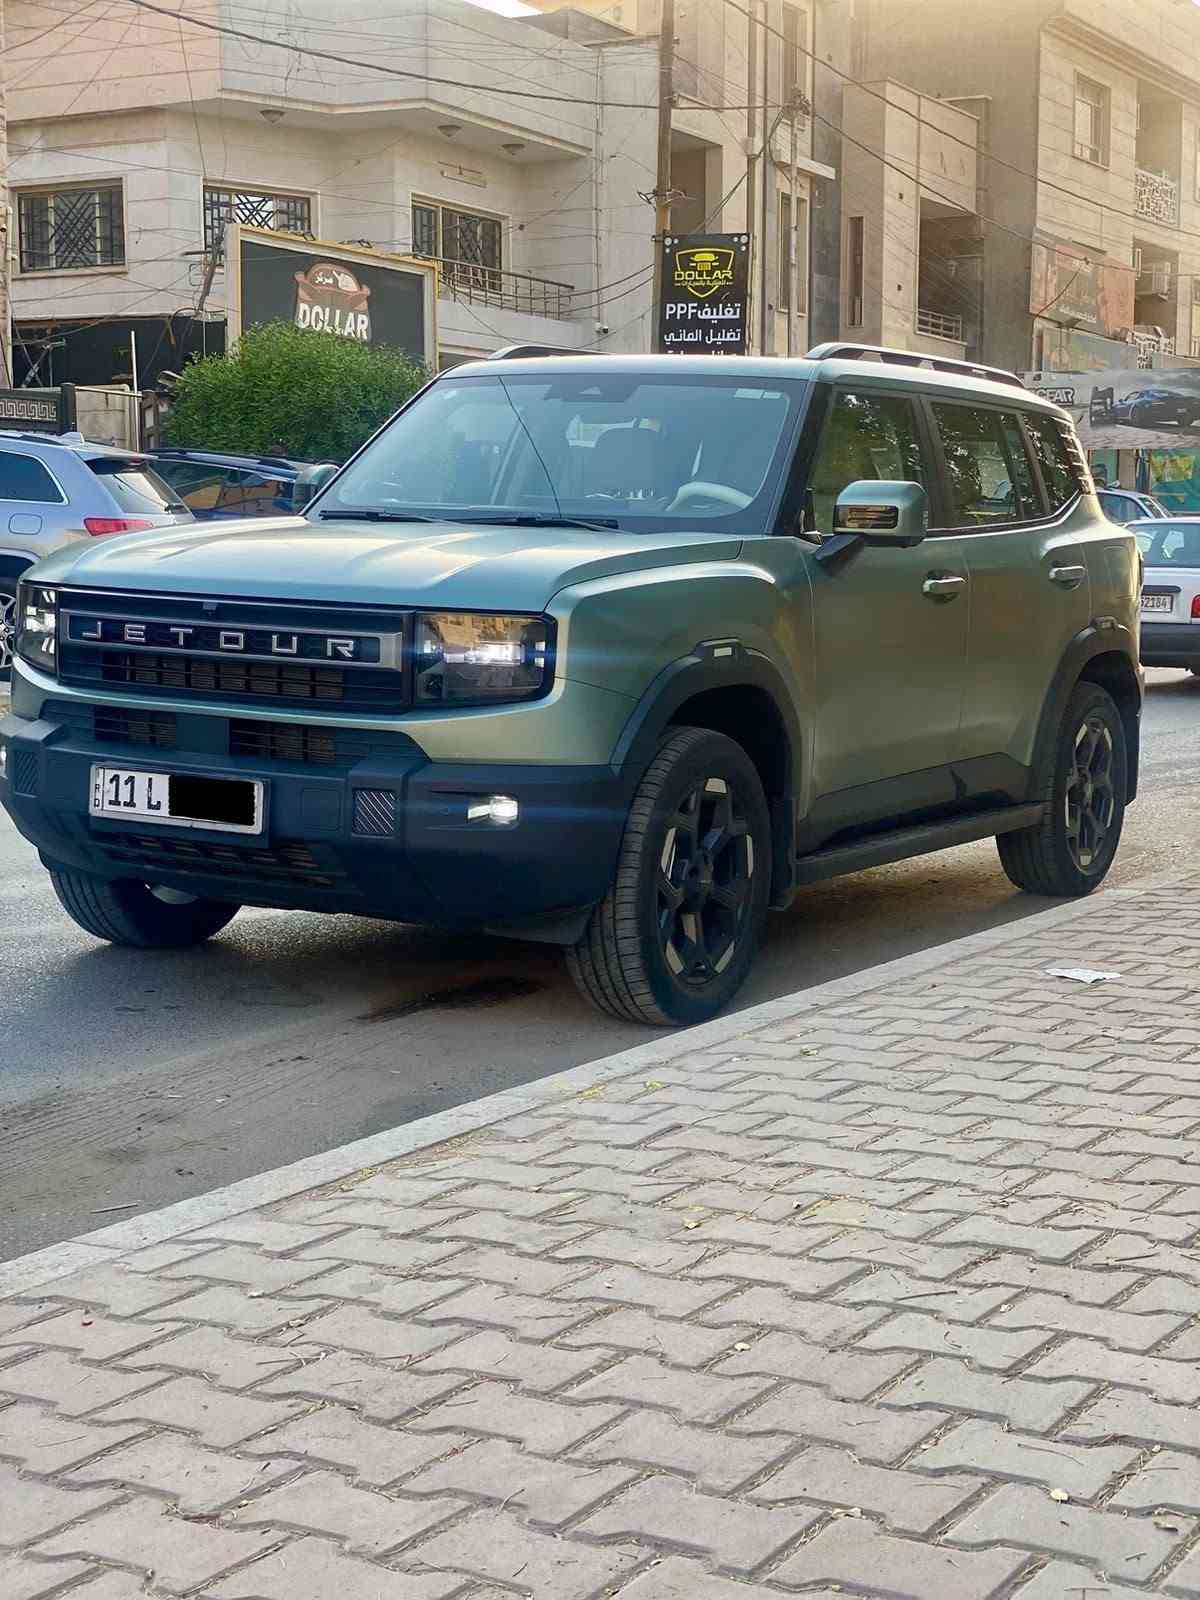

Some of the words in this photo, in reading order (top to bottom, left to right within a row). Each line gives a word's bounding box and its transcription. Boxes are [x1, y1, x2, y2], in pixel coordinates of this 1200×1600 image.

[674, 270, 733, 281] DOLLAR
[297, 303, 369, 340] DOLLAR
[665, 303, 698, 320] PPF
[697, 303, 741, 324] تغليف
[705, 328, 741, 345] تضليل
[82, 620, 354, 658] JETOUR
[108, 773, 137, 808] 11
[147, 777, 162, 810] L
